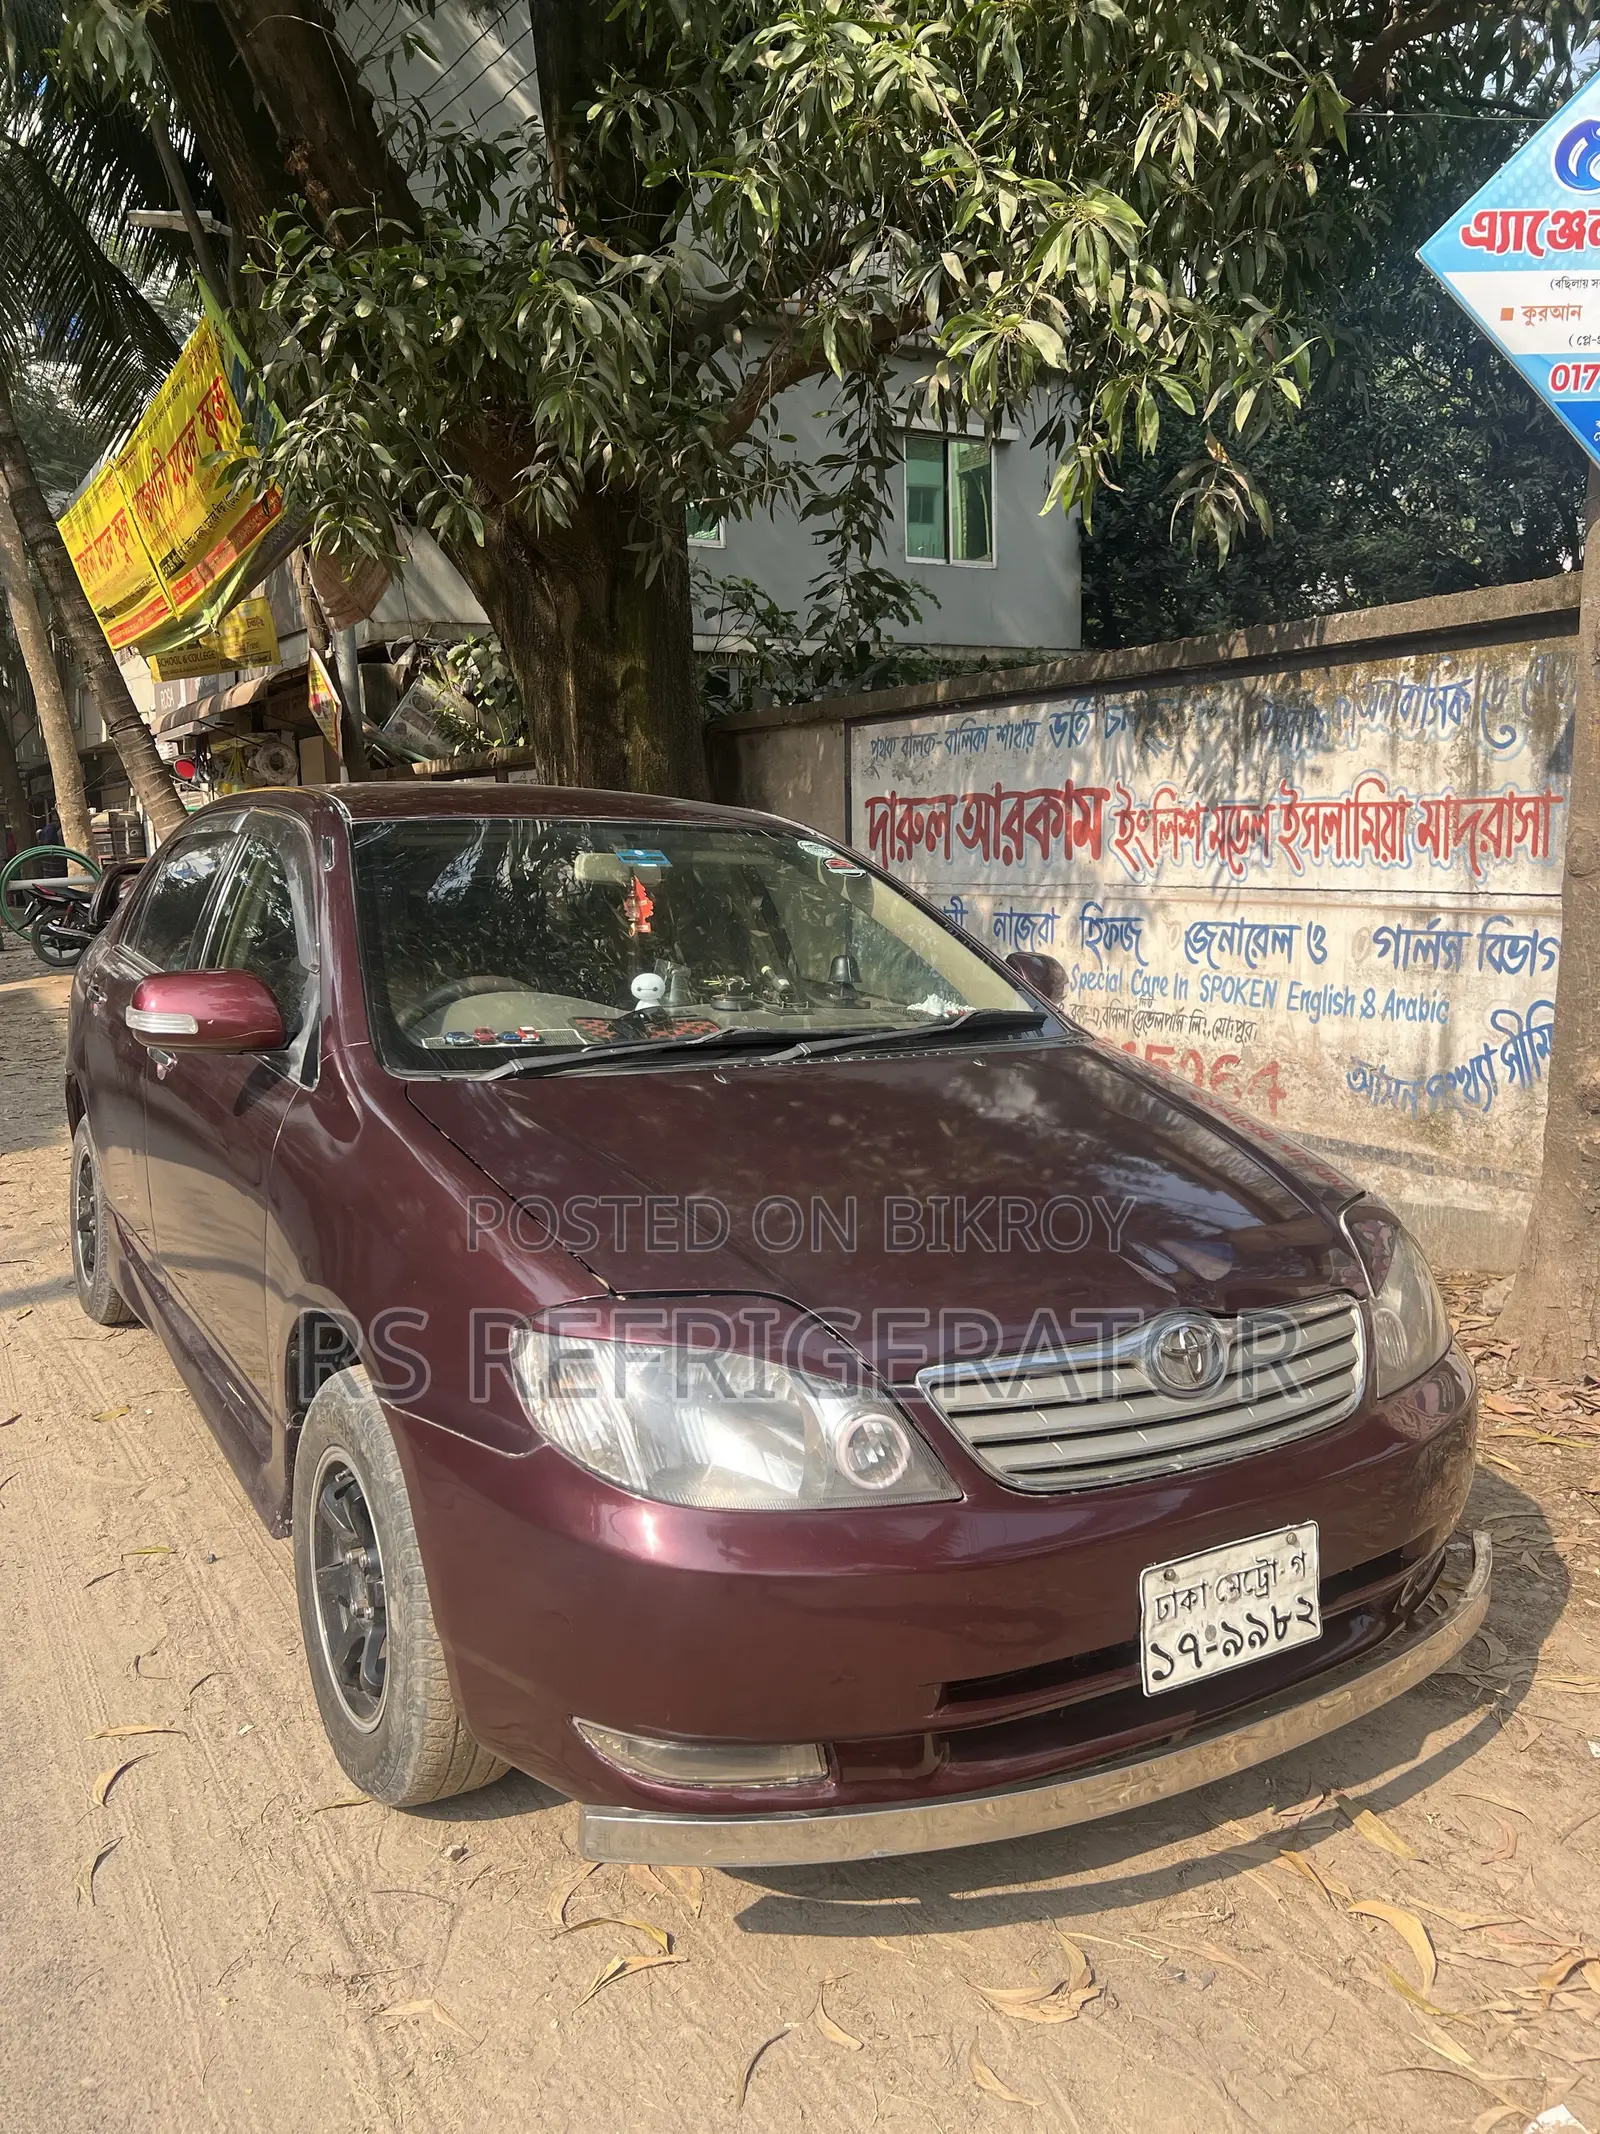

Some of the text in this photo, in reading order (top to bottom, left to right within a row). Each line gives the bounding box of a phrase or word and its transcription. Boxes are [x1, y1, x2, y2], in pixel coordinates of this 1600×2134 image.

[1521, 303, 1583, 326] কুরআন
[157, 653, 183, 667] SCHOOL
[187, 650, 217, 663] COLLEGE
[1049, 696, 1098, 749] ভর্তি
[864, 777, 1565, 877] দারুল আরকাম ইংলিশ মডেল ইসলামিয়া মাদরাসা
[1079, 901, 1150, 967] হিফজ
[1184, 917, 1303, 970] জেনারেল
[1306, 920, 1329, 965] ও
[1372, 916, 1474, 973] গার্লস
[1069, 963, 1124, 1000] Special
[1130, 968, 1169, 998] Care
[1199, 974, 1279, 1011] SPOKEN
[1286, 974, 1358, 1024] English
[1381, 988, 1450, 1025] Arabic
[1490, 999, 1556, 1089] সীমি
[1152, 1578, 1209, 1622] ঢাকা
